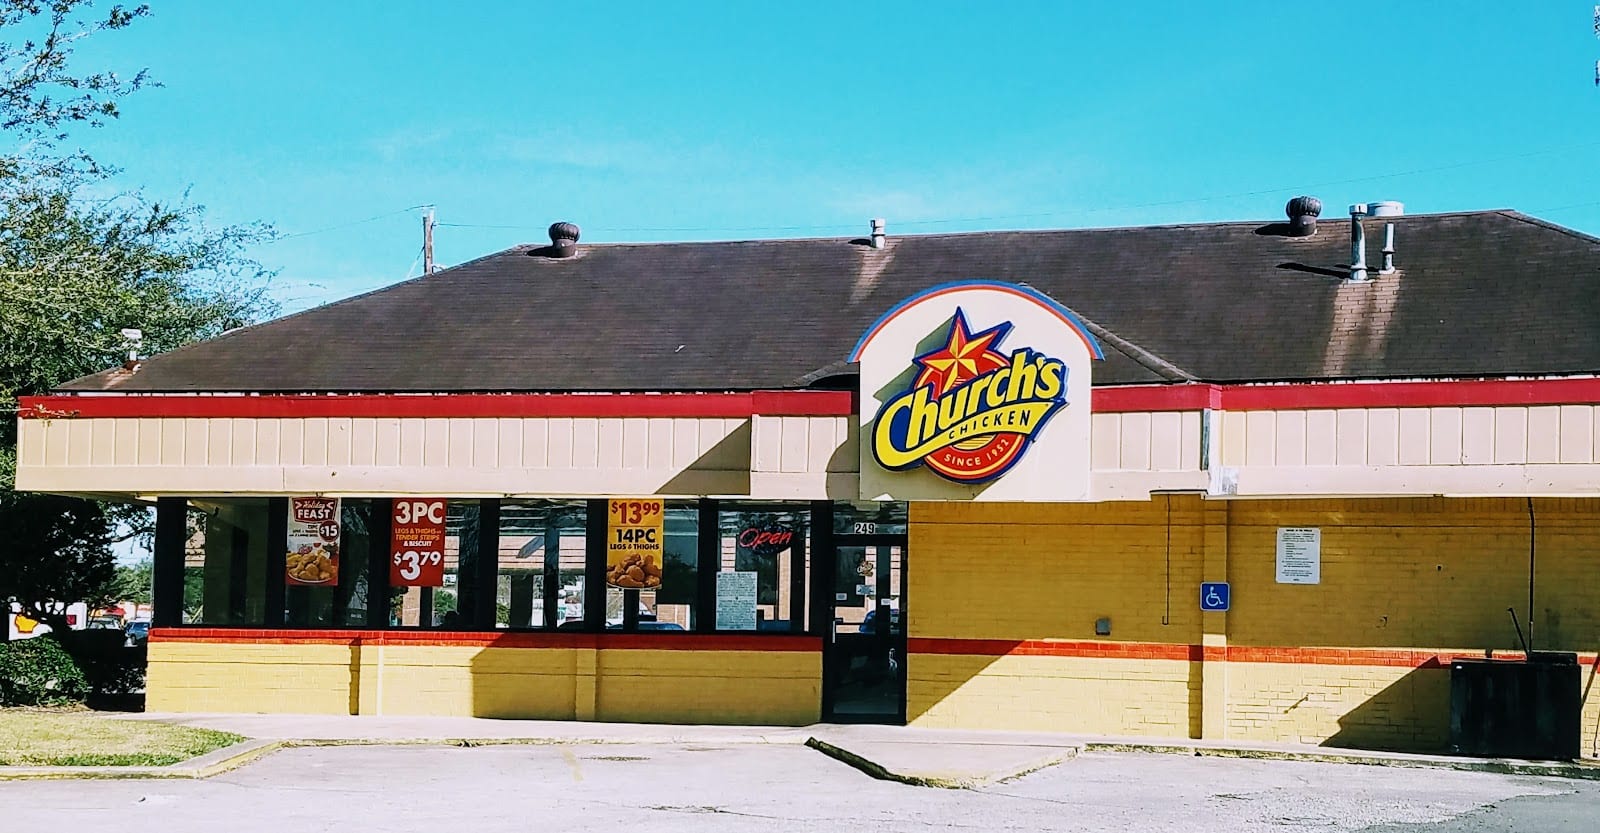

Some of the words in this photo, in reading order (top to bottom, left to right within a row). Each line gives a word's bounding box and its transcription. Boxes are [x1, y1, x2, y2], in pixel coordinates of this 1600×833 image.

[875, 351, 1063, 467] Church's
[948, 410, 1032, 440] CHICKEN
[943, 453, 982, 467] SINCE
[986, 438, 1010, 461] 1952
[297, 509, 331, 519] FEAST
[395, 501, 444, 524] 3PC
[320, 524, 338, 537] $15
[616, 528, 656, 543] 14PC
[740, 528, 793, 550] Open
[855, 523, 875, 534] 249
